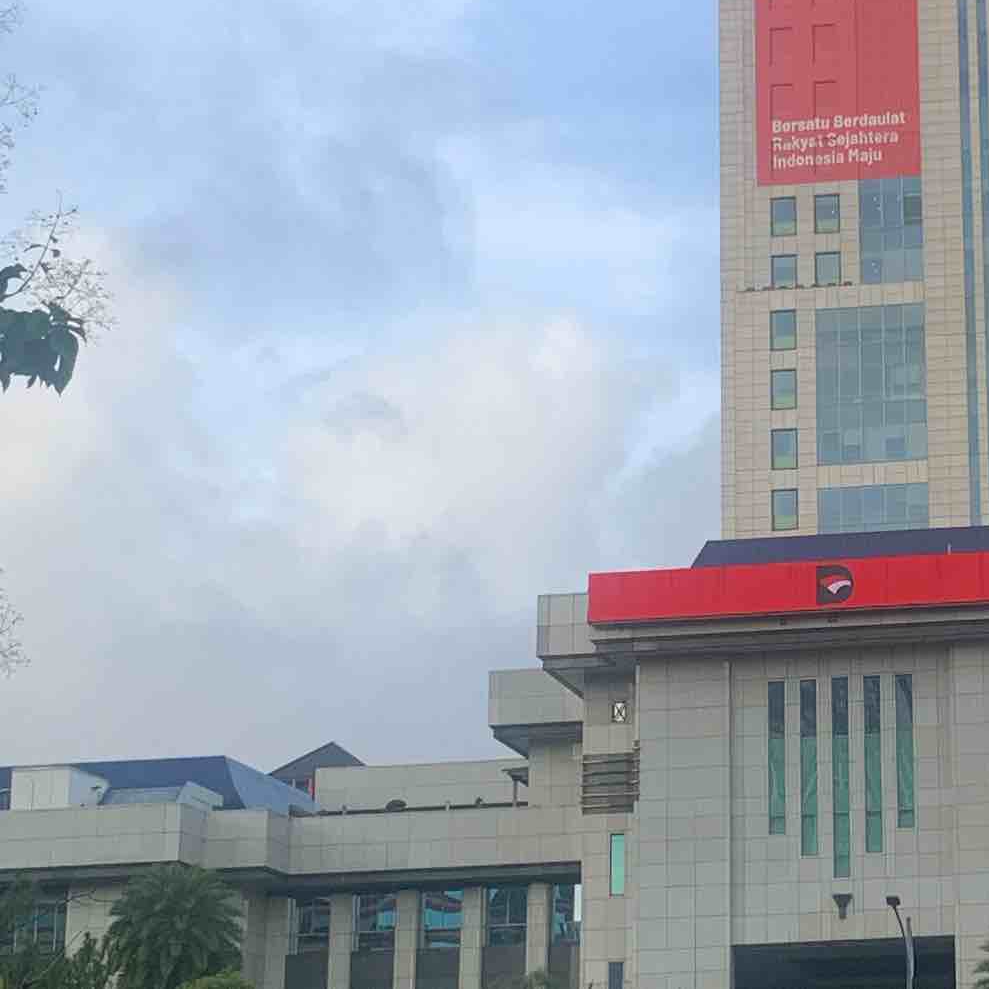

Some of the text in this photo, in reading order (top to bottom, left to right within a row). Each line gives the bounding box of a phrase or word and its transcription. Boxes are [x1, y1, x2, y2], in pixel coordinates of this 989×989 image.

[772, 112, 906, 133] Bersatu Berdaulat
[773, 130, 899, 152] Rakyat Sejahtera
[773, 147, 882, 169] Indonesia Maju
